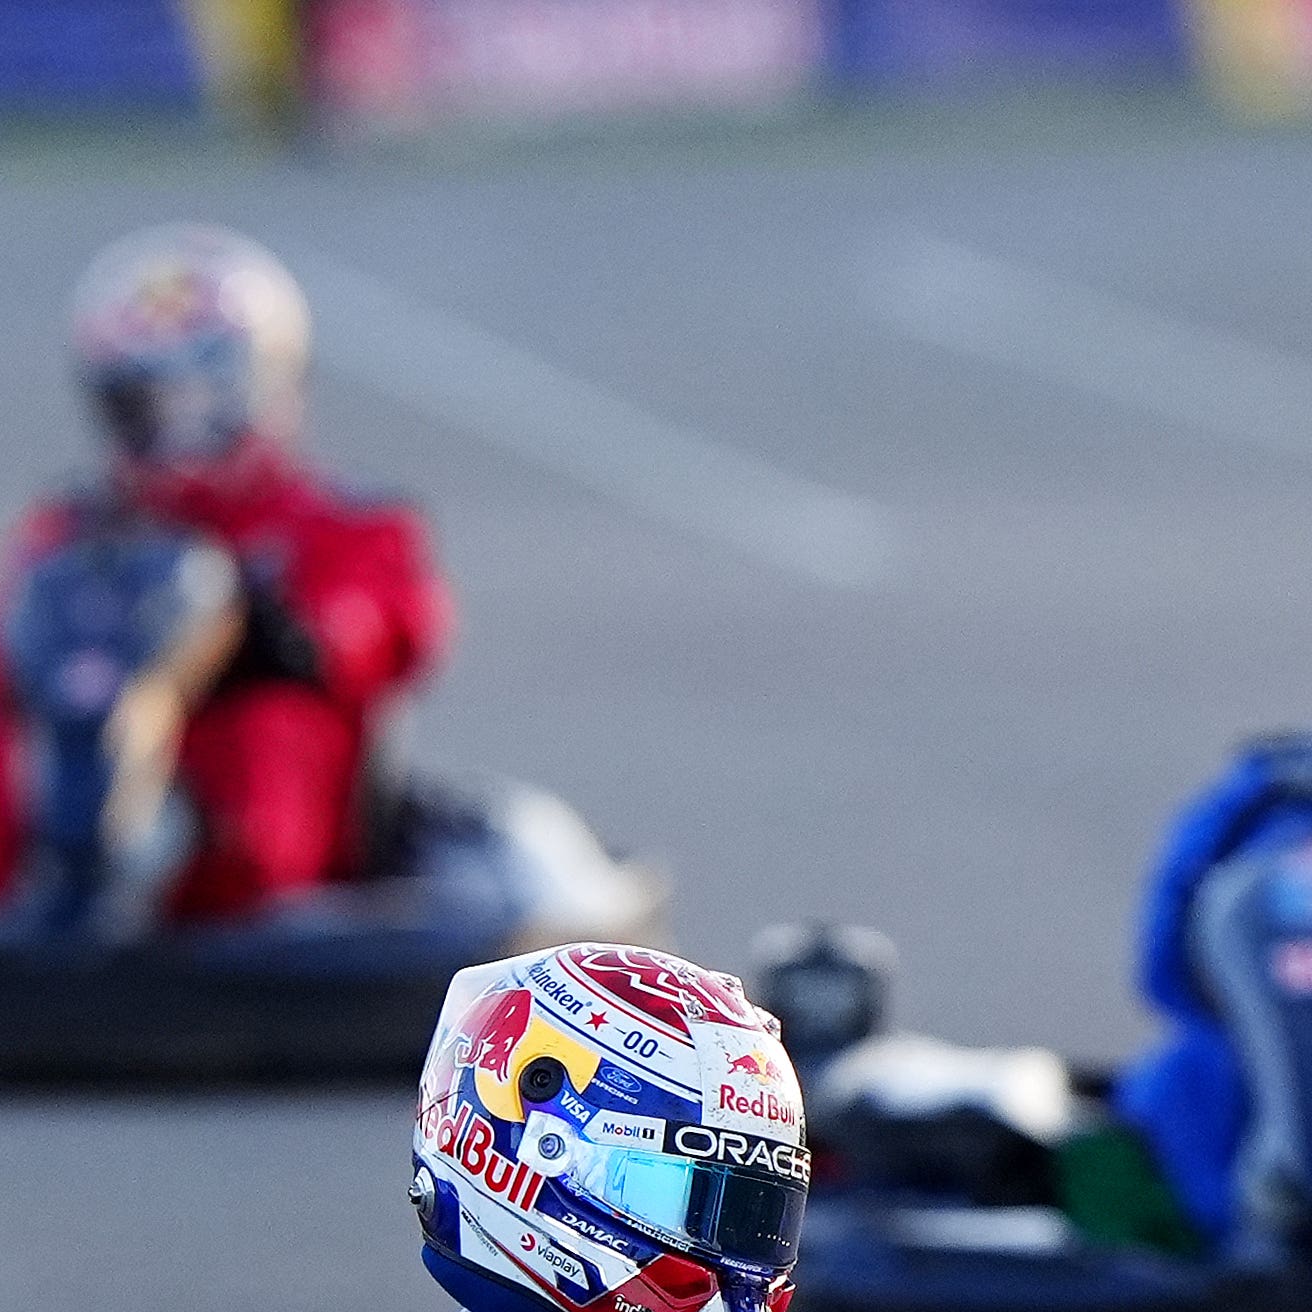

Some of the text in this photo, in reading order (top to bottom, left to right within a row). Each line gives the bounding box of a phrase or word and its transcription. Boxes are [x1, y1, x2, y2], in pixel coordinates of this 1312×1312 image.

[606, 1070, 636, 1089] Ford
[560, 1090, 591, 1123] VISA
[719, 1084, 796, 1126] Red Bull
[602, 1122, 641, 1138] Mobil
[461, 1117, 543, 1212] Bull
[561, 1213, 630, 1251] DAMAC
[536, 1243, 581, 1278] viaplay
